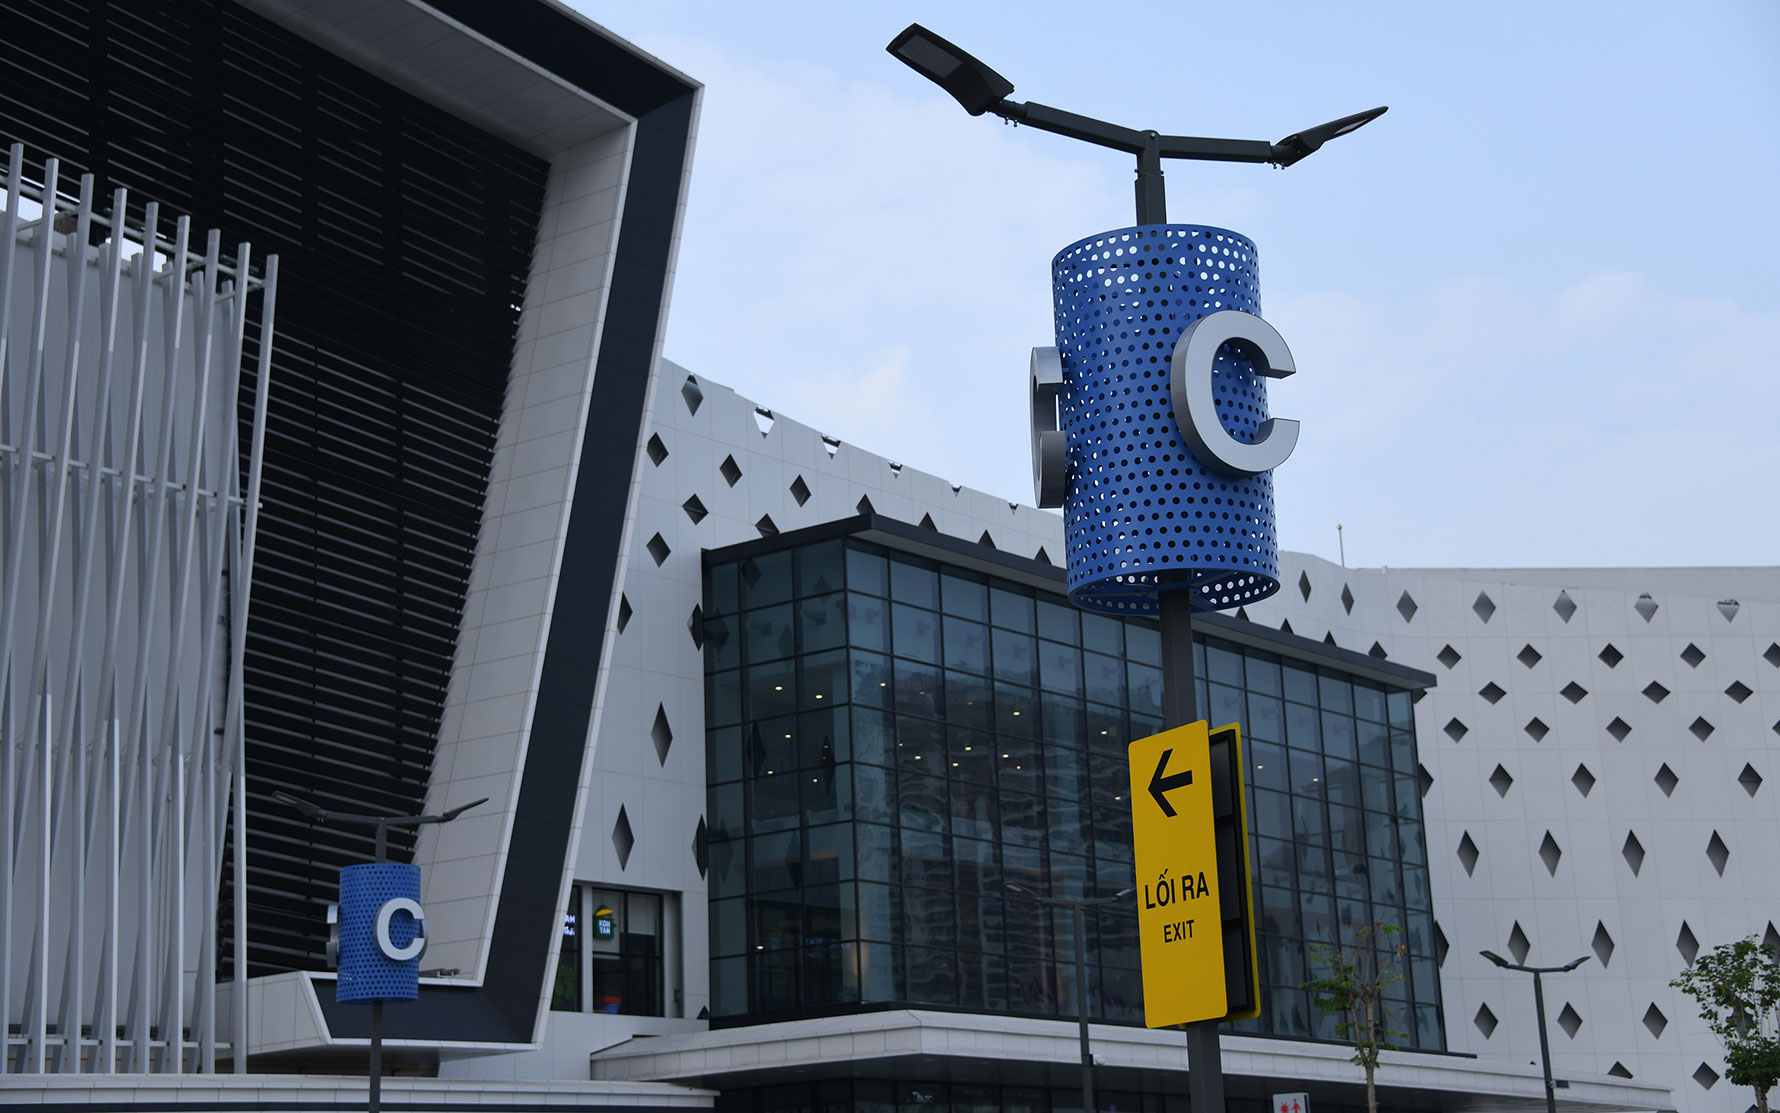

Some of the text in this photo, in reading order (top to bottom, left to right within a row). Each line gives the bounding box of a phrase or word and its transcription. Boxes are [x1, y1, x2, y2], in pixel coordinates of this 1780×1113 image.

[1171, 310, 1300, 478] C
[1145, 868, 1209, 909] LỐI RA
[375, 897, 425, 961] C
[1164, 920, 1195, 943] EXIT
